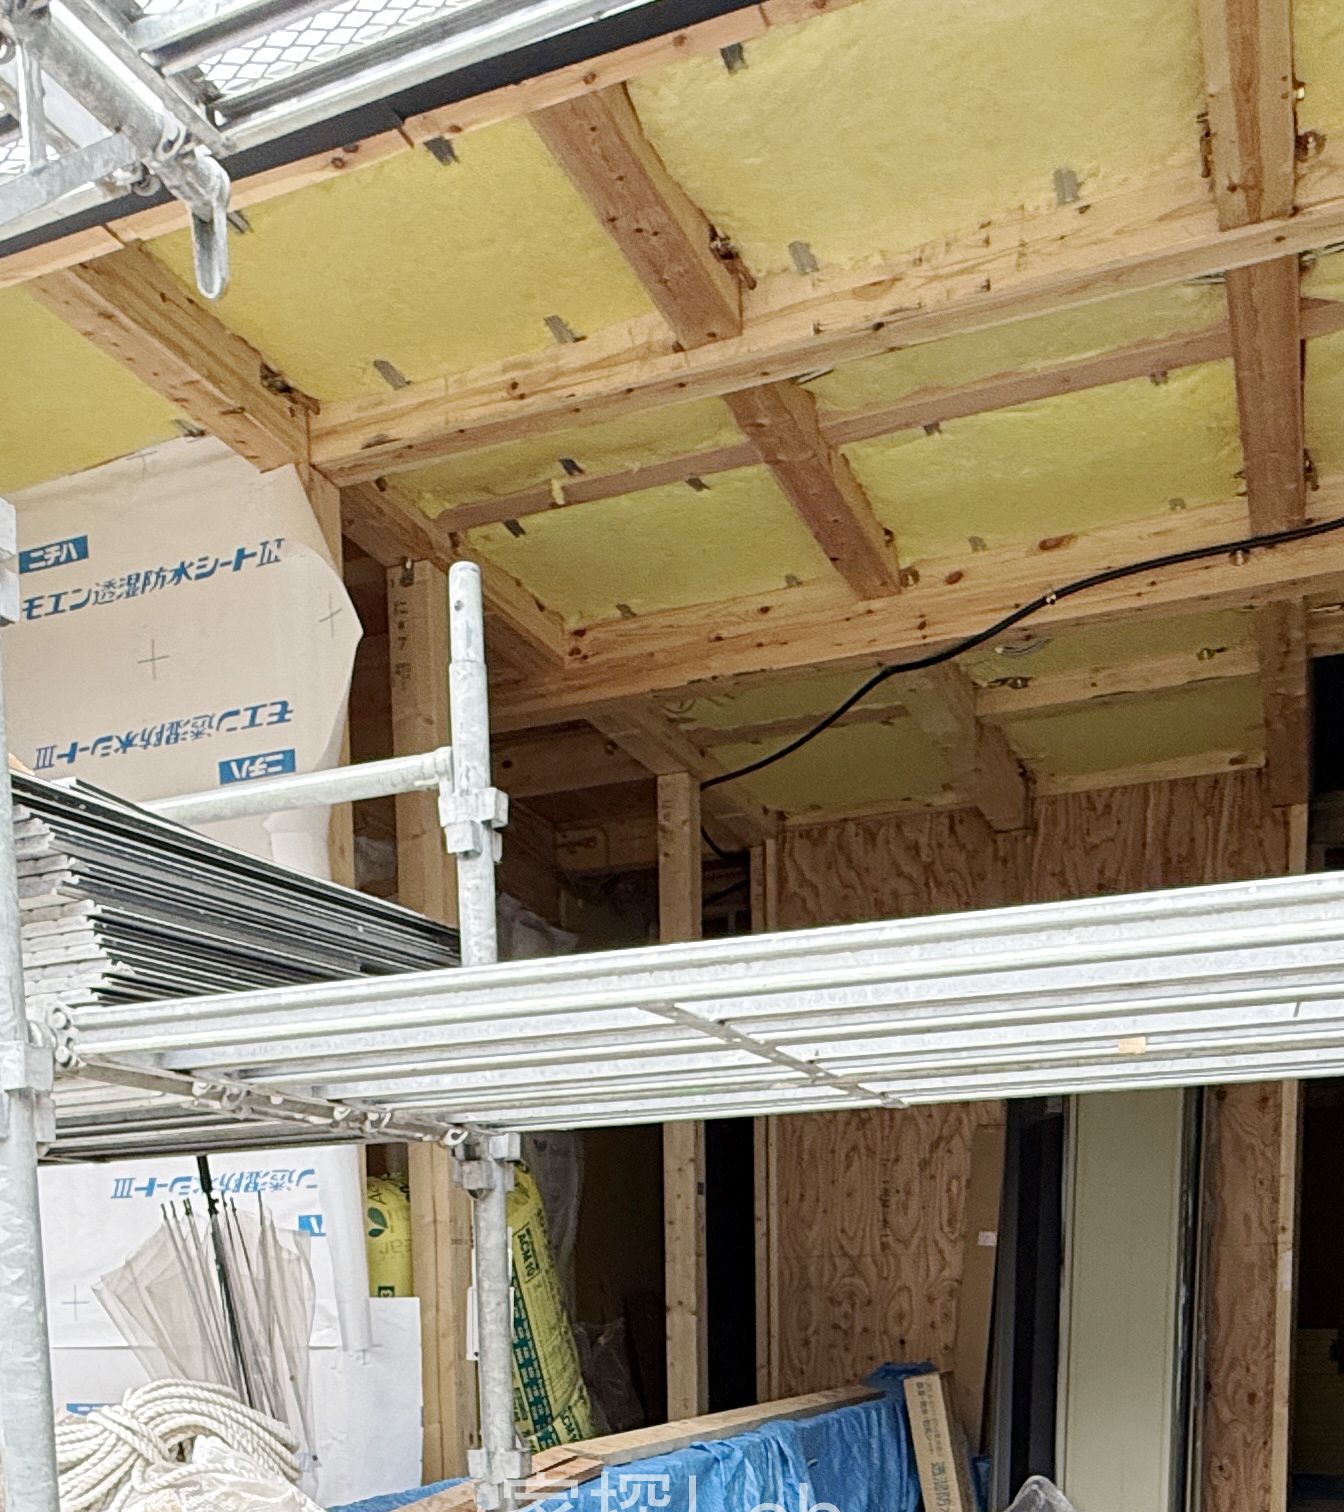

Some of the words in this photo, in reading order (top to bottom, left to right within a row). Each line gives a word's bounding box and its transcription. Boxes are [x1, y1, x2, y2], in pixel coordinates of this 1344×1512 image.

[23, 539, 86, 573] ニチハ
[226, 751, 289, 782] ニチハ
